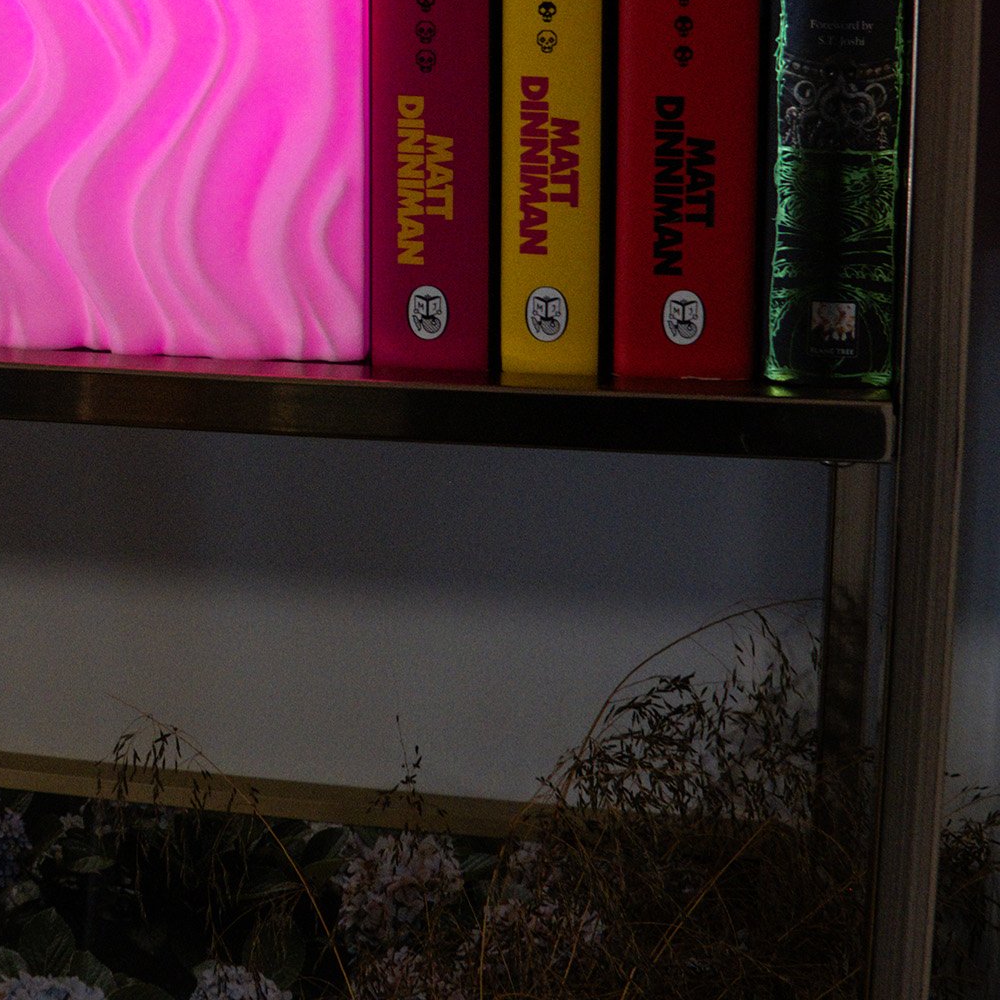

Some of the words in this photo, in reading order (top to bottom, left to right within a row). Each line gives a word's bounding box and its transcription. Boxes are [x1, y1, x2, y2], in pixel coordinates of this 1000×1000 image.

[397, 95, 425, 265] DINNIMAN
[425, 134, 454, 221] MATT
[520, 76, 549, 255] DINNIMAN
[550, 117, 579, 207] MATT
[654, 96, 685, 276] DINNIMAN
[686, 137, 716, 227] MATT
